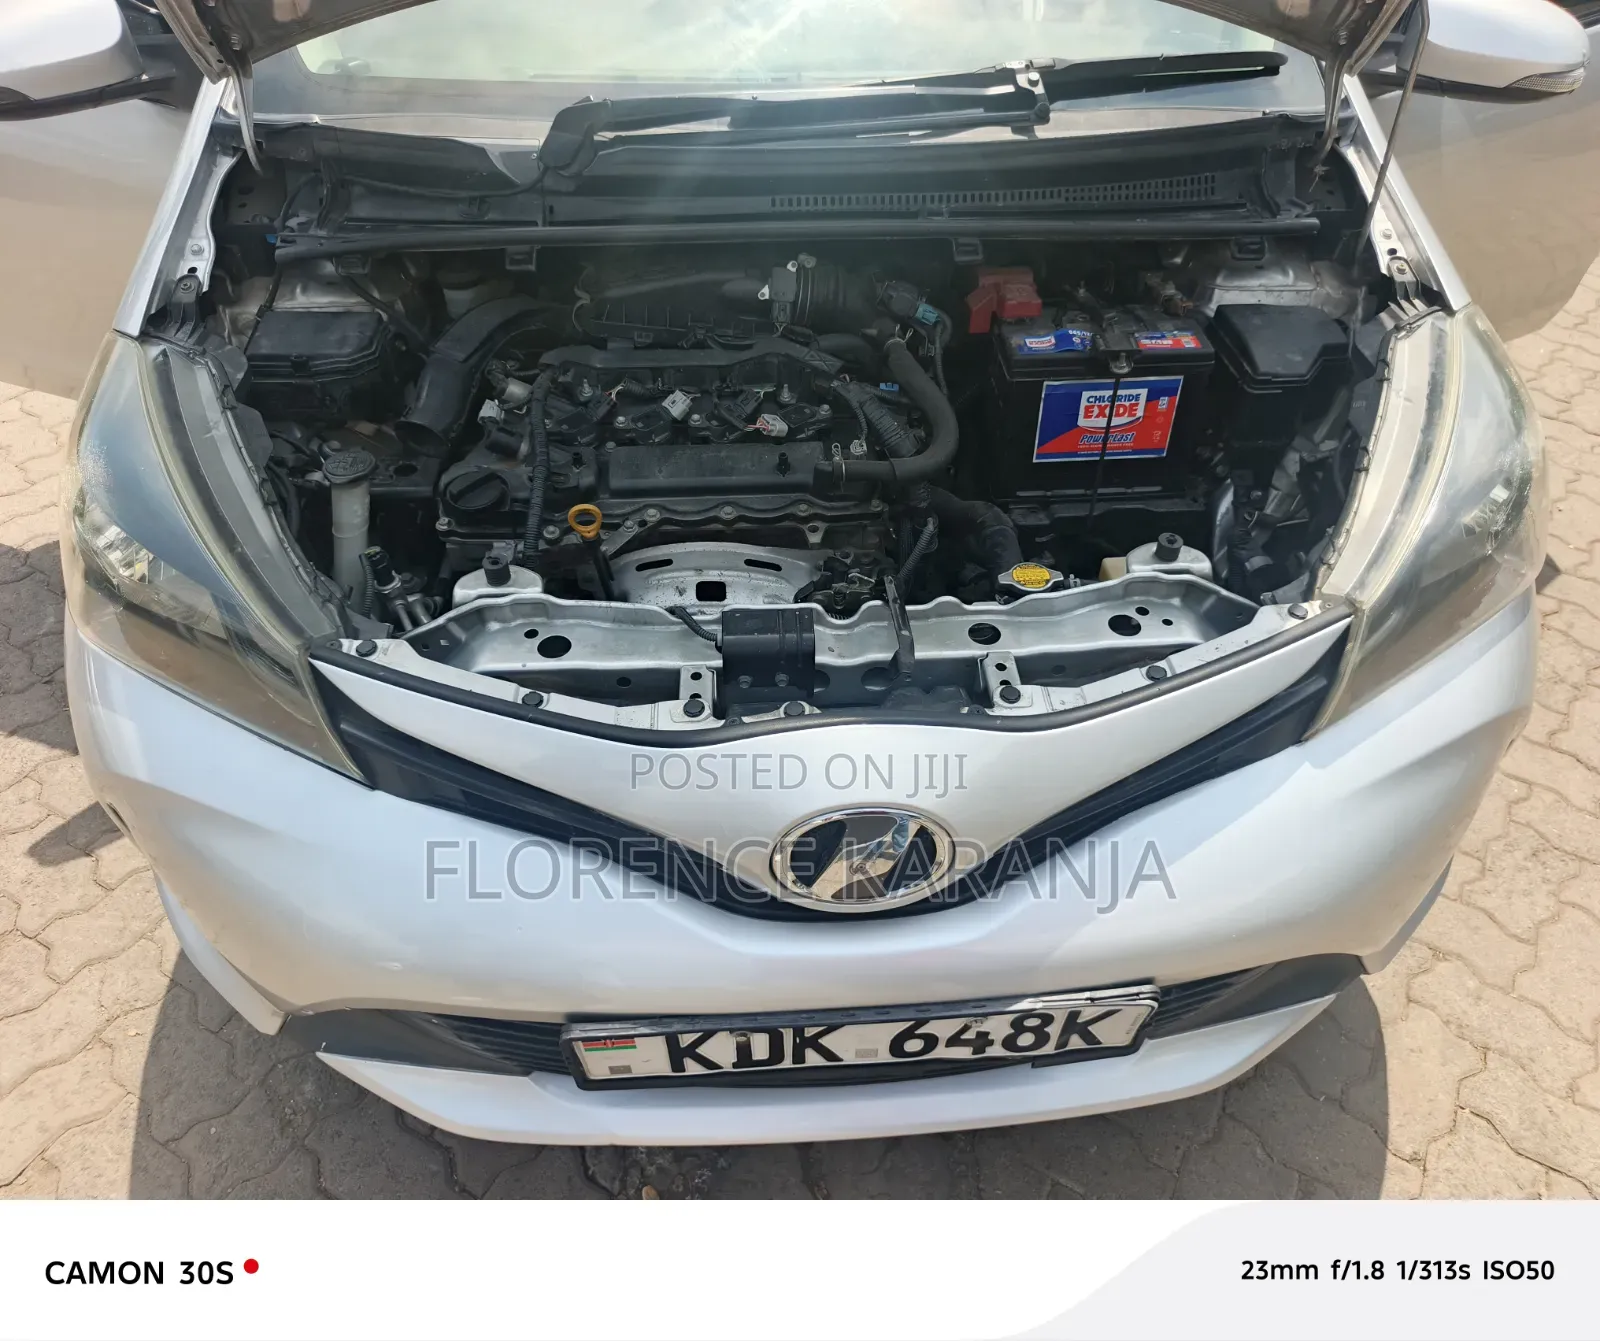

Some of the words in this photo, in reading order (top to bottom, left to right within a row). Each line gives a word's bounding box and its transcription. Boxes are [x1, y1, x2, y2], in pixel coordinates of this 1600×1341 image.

[1083, 402, 1140, 419] EXDE
[664, 1022, 845, 1074] KDK
[887, 1007, 1124, 1060] 648K
